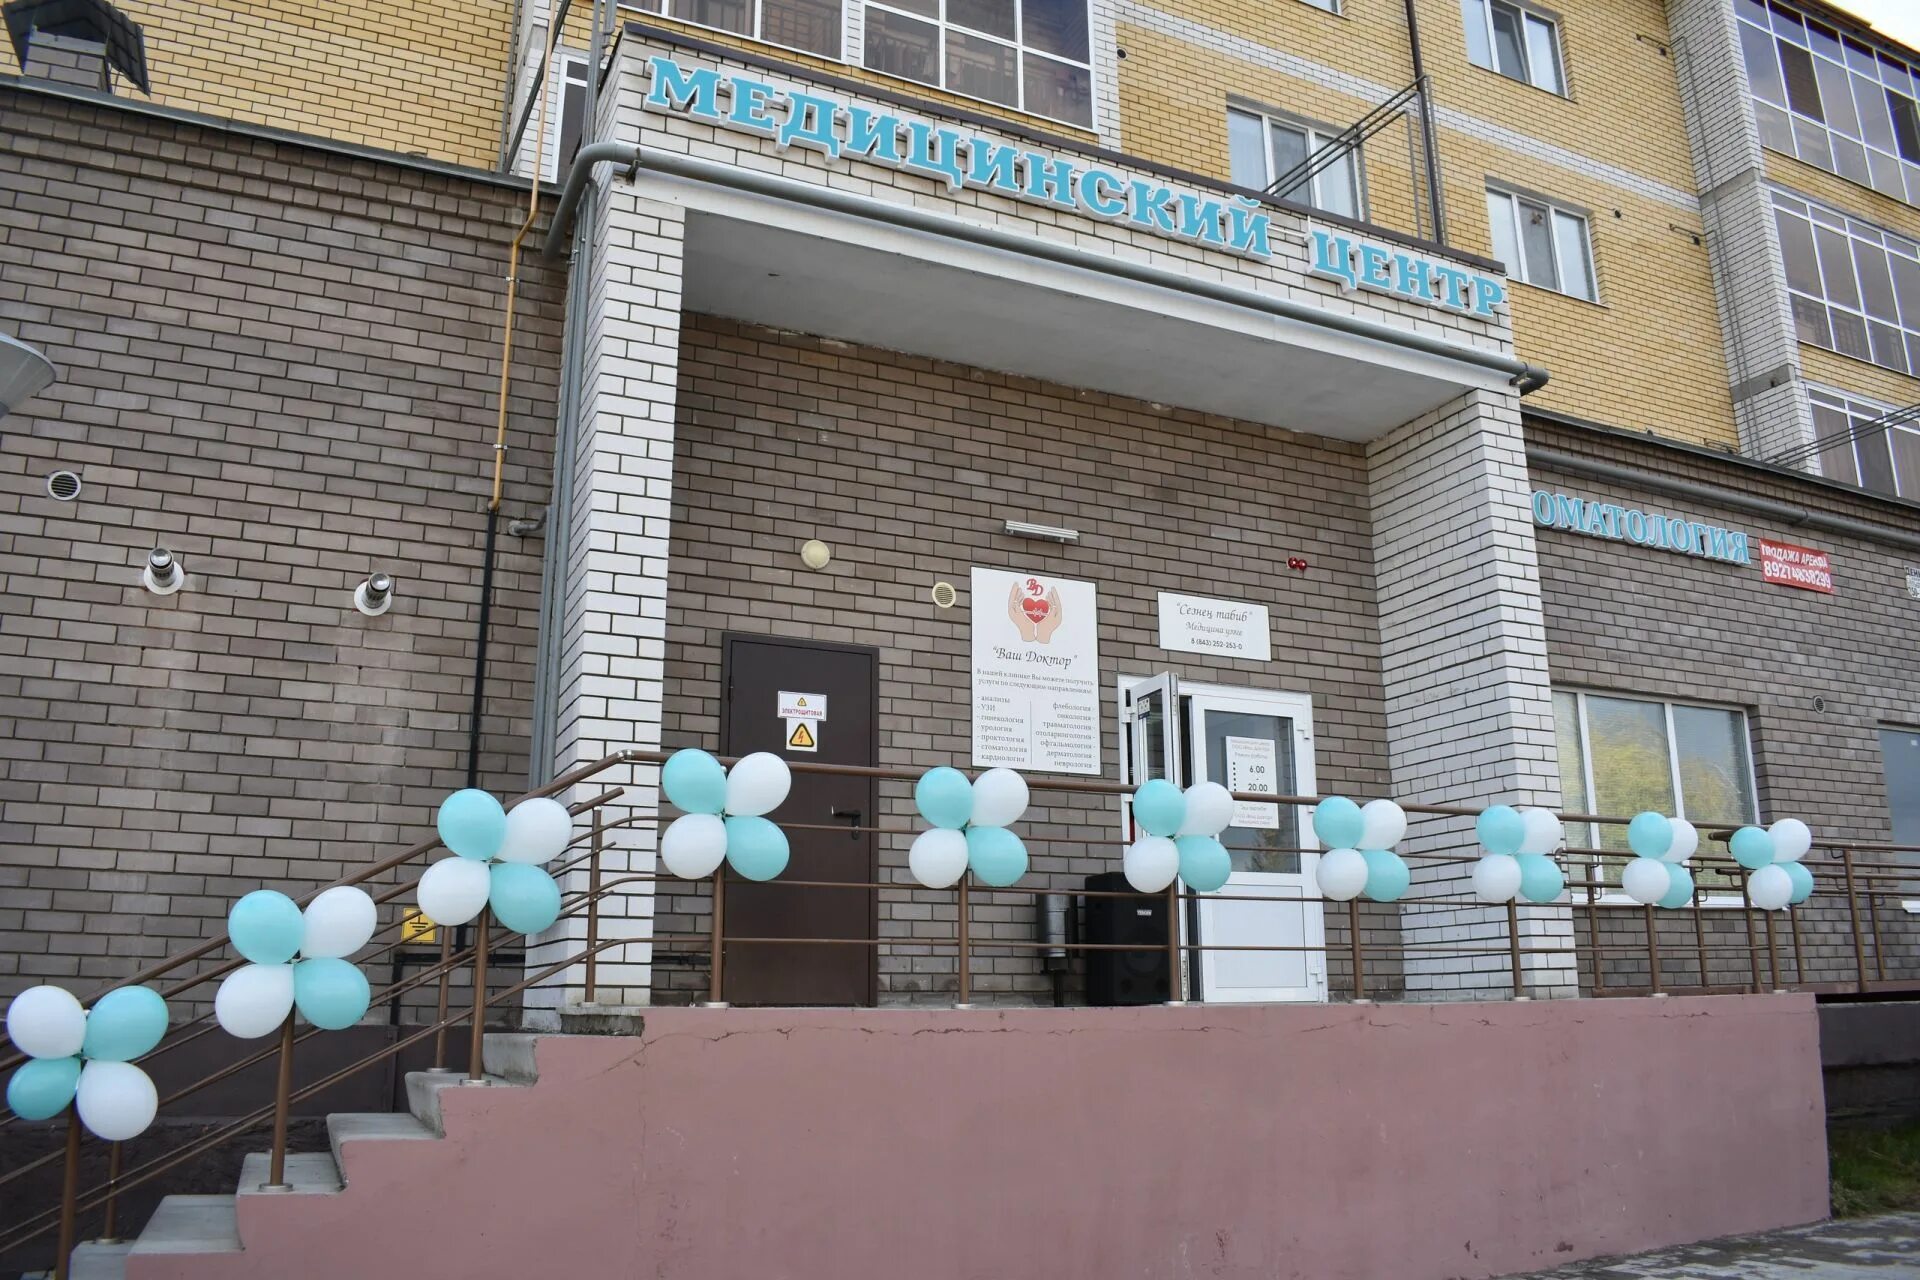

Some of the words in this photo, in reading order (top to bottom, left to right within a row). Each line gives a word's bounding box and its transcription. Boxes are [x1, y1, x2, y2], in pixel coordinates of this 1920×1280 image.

[645, 56, 1272, 260] МЕДИЦИНСКИЙ
[1308, 230, 1504, 320] ЦЕНТР
[1533, 490, 1751, 565] ОМАТОЛОГИЯ
[1248, 783, 1268, 792] 20.00
[1249, 765, 1265, 774] 6.00
